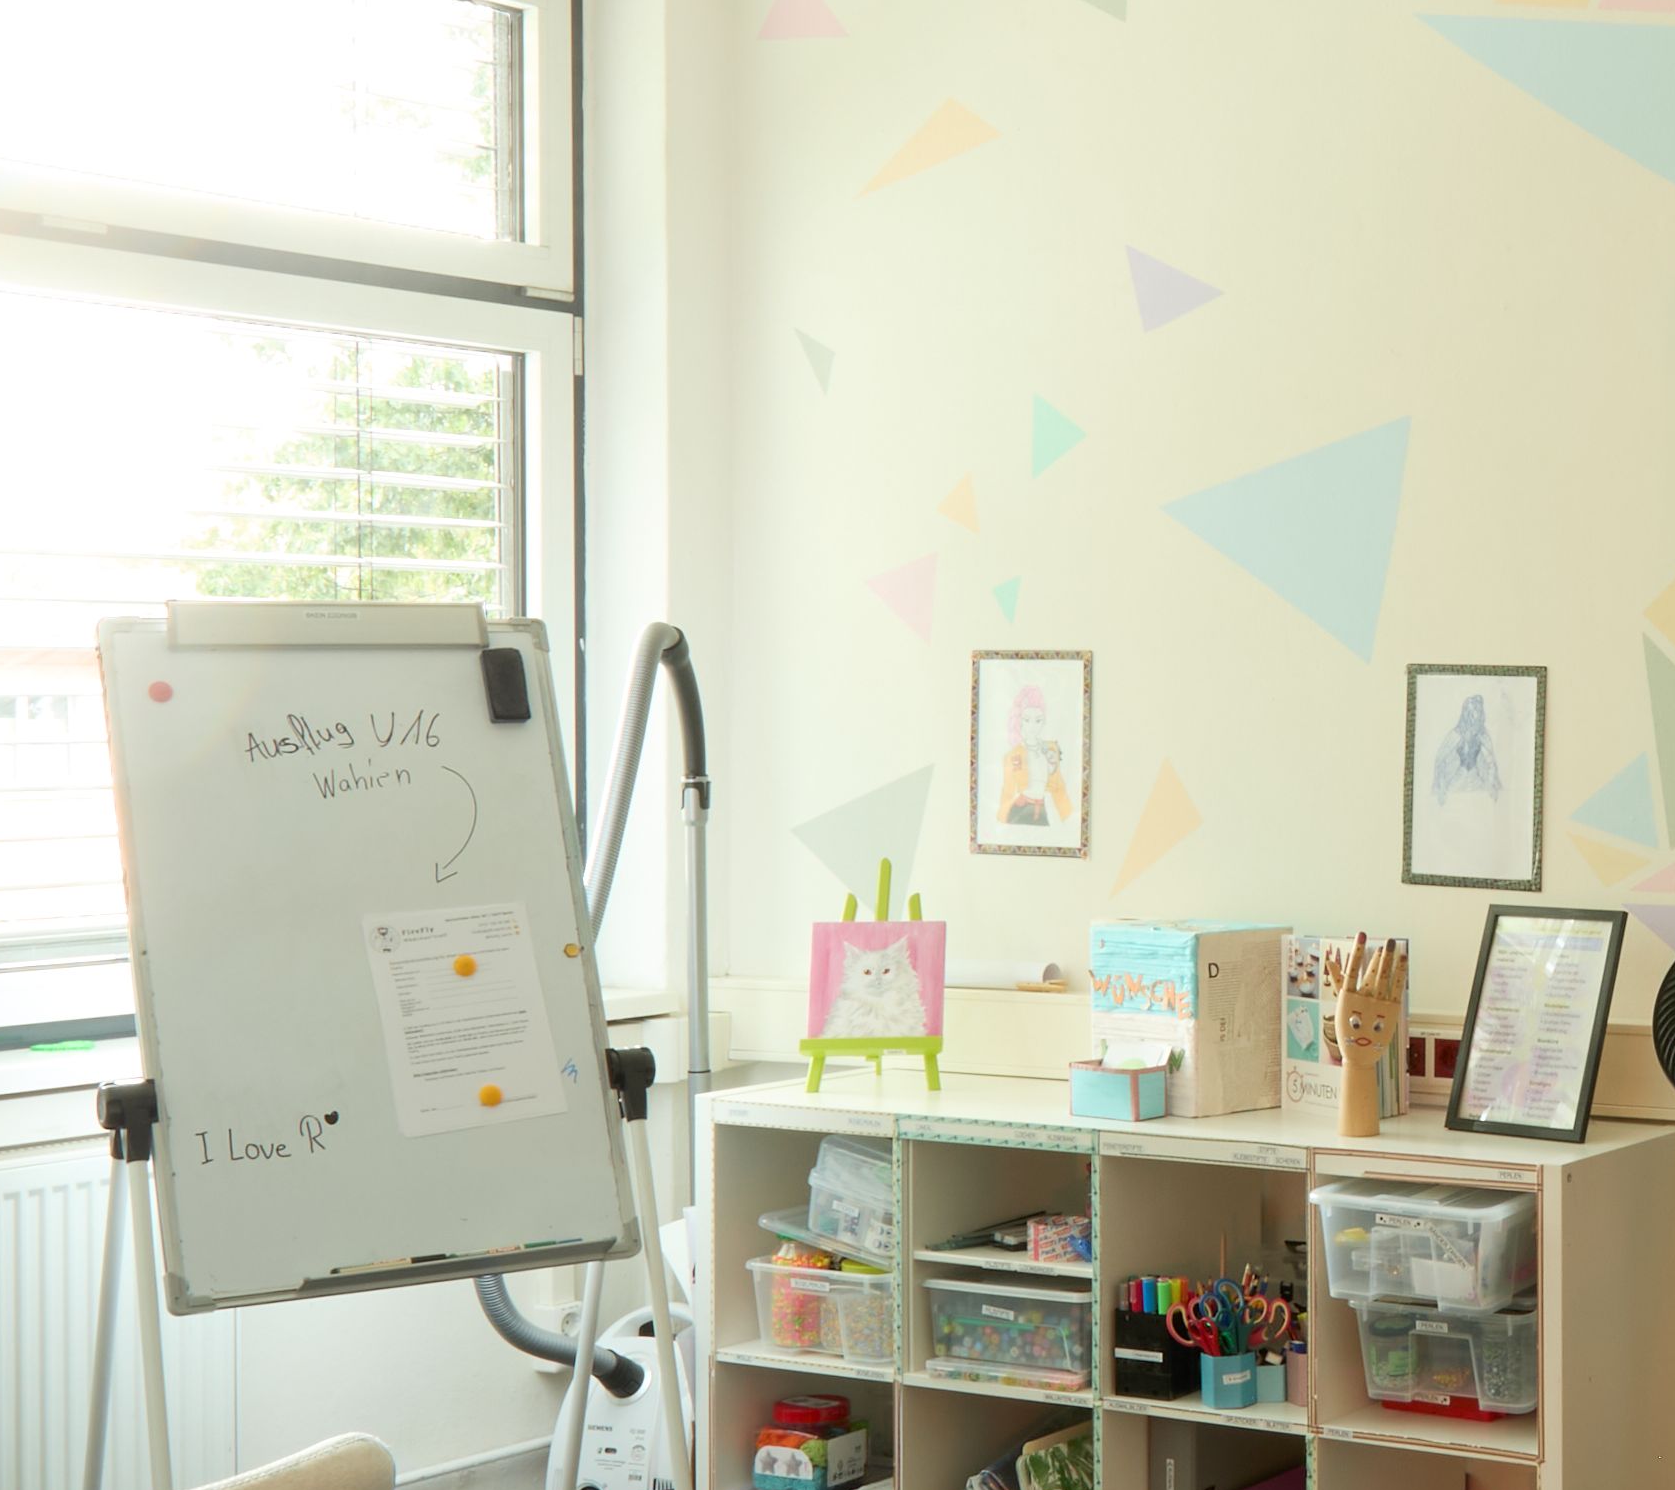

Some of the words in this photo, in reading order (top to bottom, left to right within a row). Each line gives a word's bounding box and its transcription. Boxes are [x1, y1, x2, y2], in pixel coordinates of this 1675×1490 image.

[244, 713, 355, 763] Ausflug
[1088, 969, 1192, 1021] WÜNSCHE
[1291, 1078, 1299, 1094] 5
[1302, 1081, 1338, 1100] MINUTEN
[588, 1424, 613, 1432] SIEMENS
